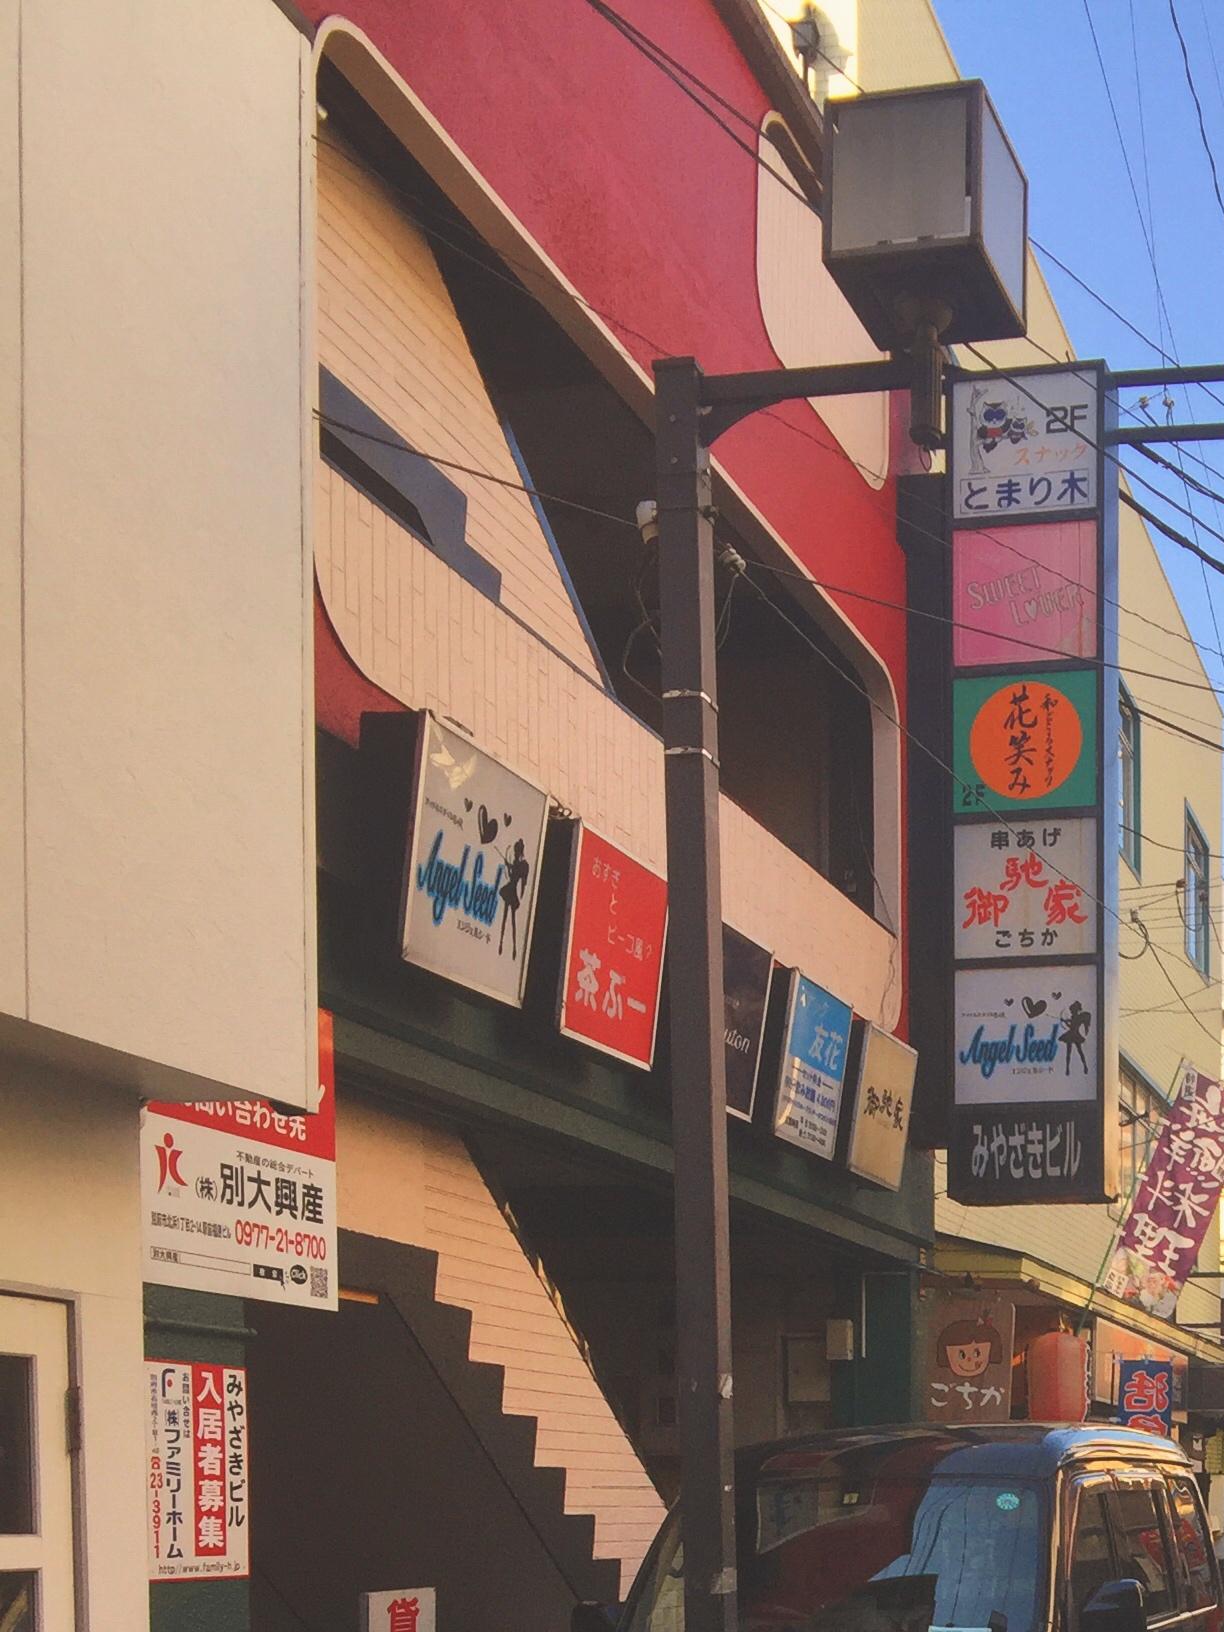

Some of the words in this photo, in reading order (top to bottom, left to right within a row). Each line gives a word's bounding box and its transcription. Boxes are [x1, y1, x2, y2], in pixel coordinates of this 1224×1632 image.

[963, 471, 1089, 510] とまり木
[966, 563, 1041, 610] SWEET
[1003, 685, 1038, 794] 花笑み
[990, 828, 1061, 850] 串あげ
[417, 829, 470, 926] Angel
[464, 853, 503, 927] Seed
[995, 928, 1058, 949] ごちか
[960, 1023, 1017, 1079] Angel
[1015, 1022, 1060, 1064] Seed
[187, 1099, 306, 1142] 問い合わせ先
[236, 1150, 315, 1180] 不動産の総合デパート
[971, 1121, 1082, 1179] みやざきビル
[235, 1218, 327, 1261] 0977-21-8700
[930, 1381, 1005, 1410] ごちか
[197, 1371, 225, 1549] 入居者募集
[226, 1373, 247, 1528] みやざきビル
